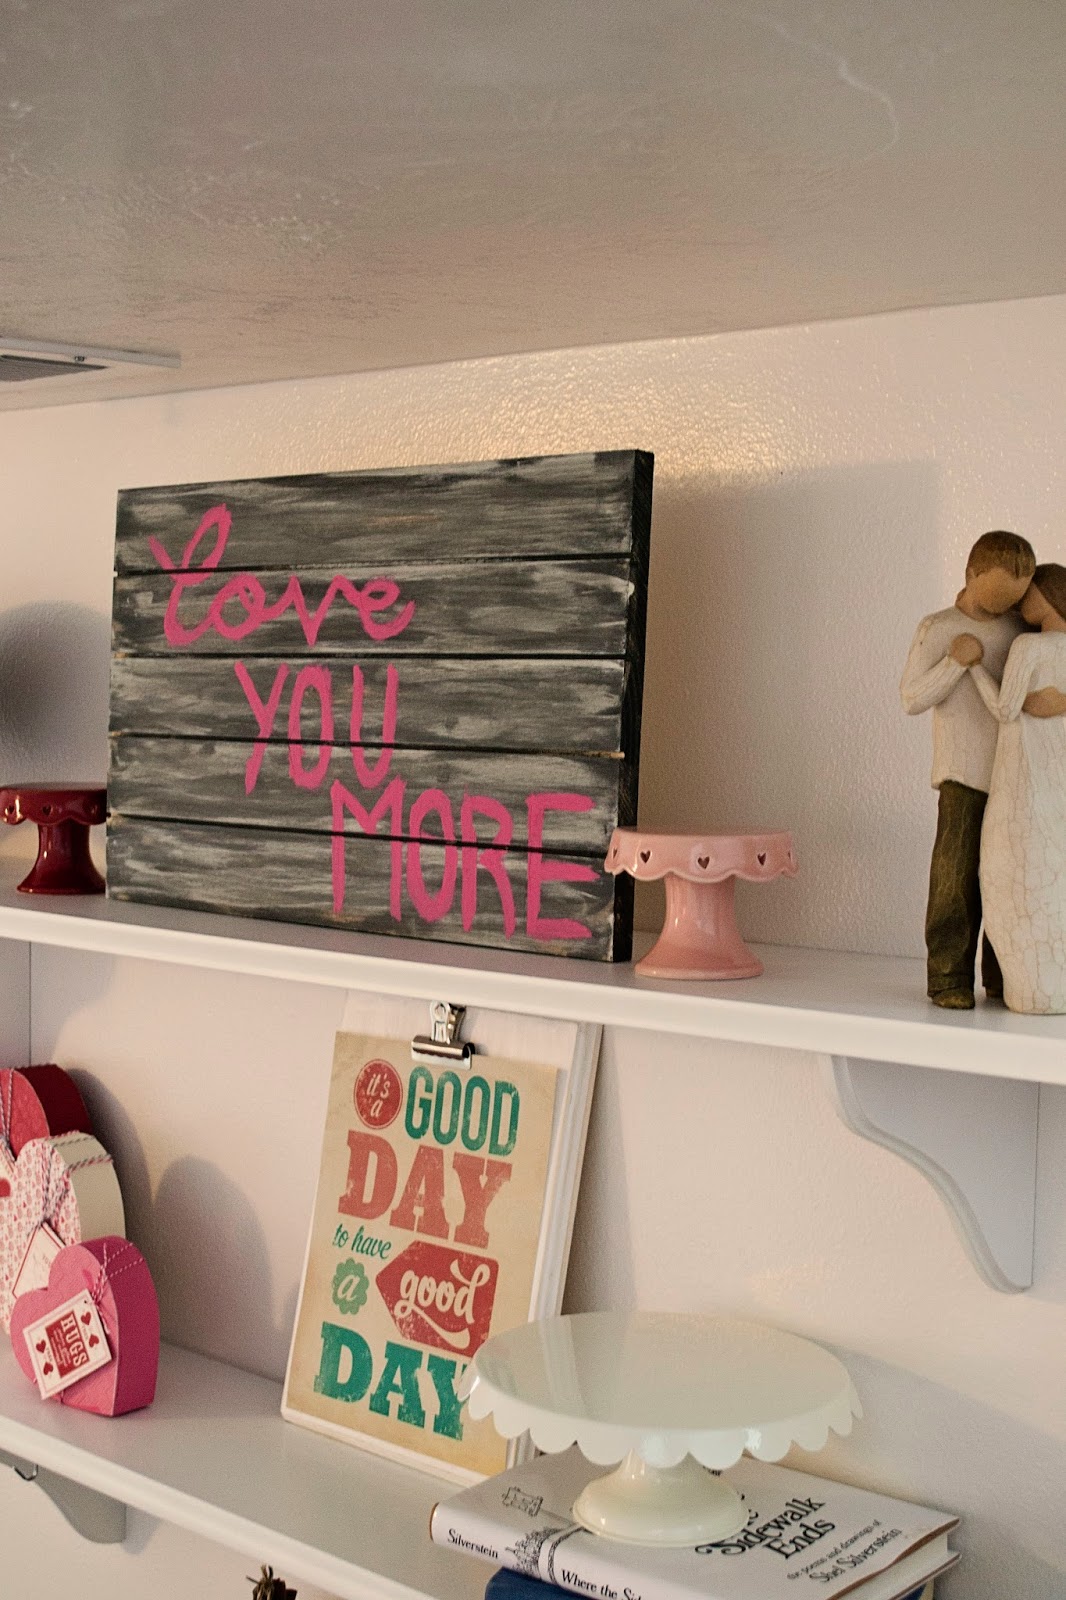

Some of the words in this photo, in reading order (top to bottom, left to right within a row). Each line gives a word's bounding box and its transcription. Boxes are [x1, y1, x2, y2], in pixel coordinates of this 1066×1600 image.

[148, 503, 415, 646] Love
[235, 661, 399, 795] YOU
[330, 778, 600, 940] MORE
[366, 1073, 391, 1098] it's
[370, 1100, 383, 1118] a
[404, 1065, 520, 1157] GOOD
[338, 1129, 513, 1250] DAY
[332, 1223, 349, 1248] to
[351, 1225, 392, 1260] have
[337, 1274, 361, 1301] a
[394, 1258, 491, 1350] good
[60, 1313, 88, 1367] HUGS
[313, 1320, 470, 1442] DAY
[447, 1528, 499, 1560] Silverstein
[561, 1568, 598, 1593] Where
[600, 1584, 618, 1599] the
[763, 1519, 836, 1560] Ends
